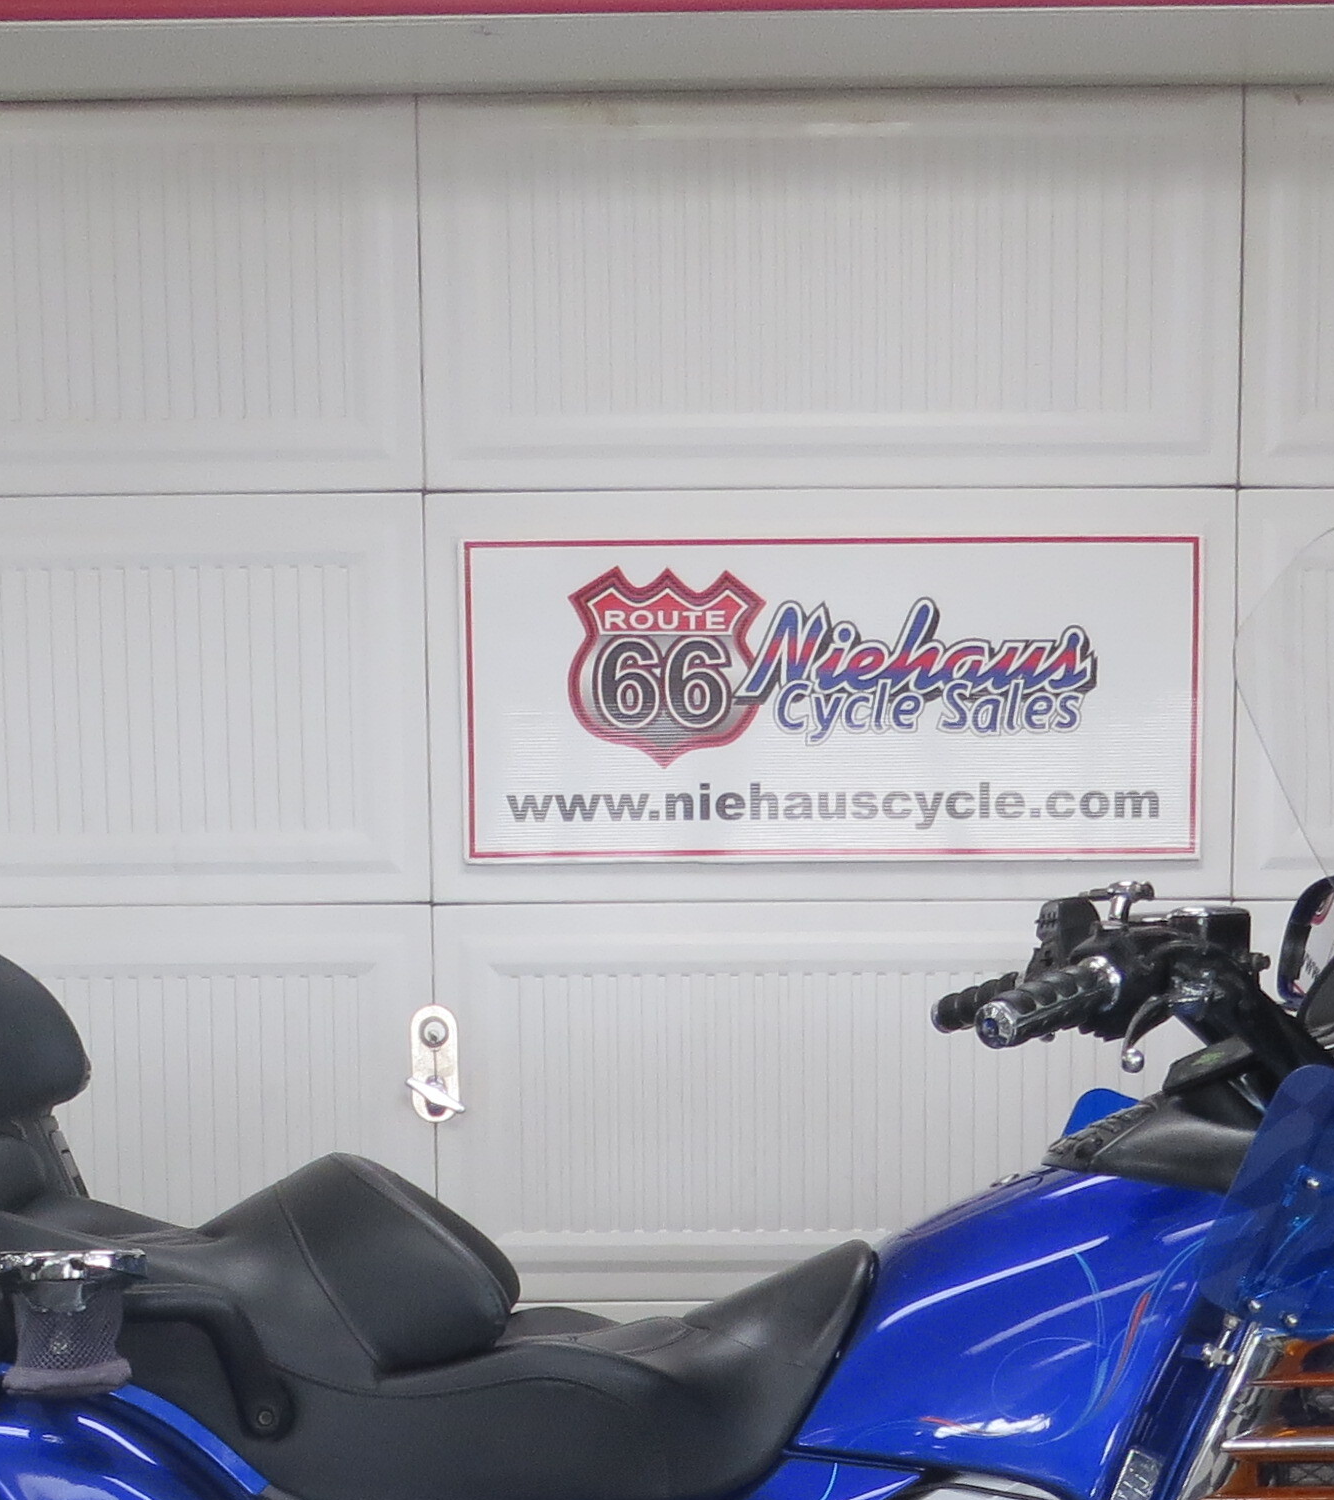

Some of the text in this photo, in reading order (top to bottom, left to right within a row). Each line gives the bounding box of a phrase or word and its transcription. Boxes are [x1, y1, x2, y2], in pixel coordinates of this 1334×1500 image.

[604, 610, 727, 632] ROUTE
[735, 598, 1096, 705] Niehaus
[597, 636, 732, 730] 66
[775, 681, 1082, 743] Cycle Sales
[506, 783, 1160, 830] www.niehauscycle.com
